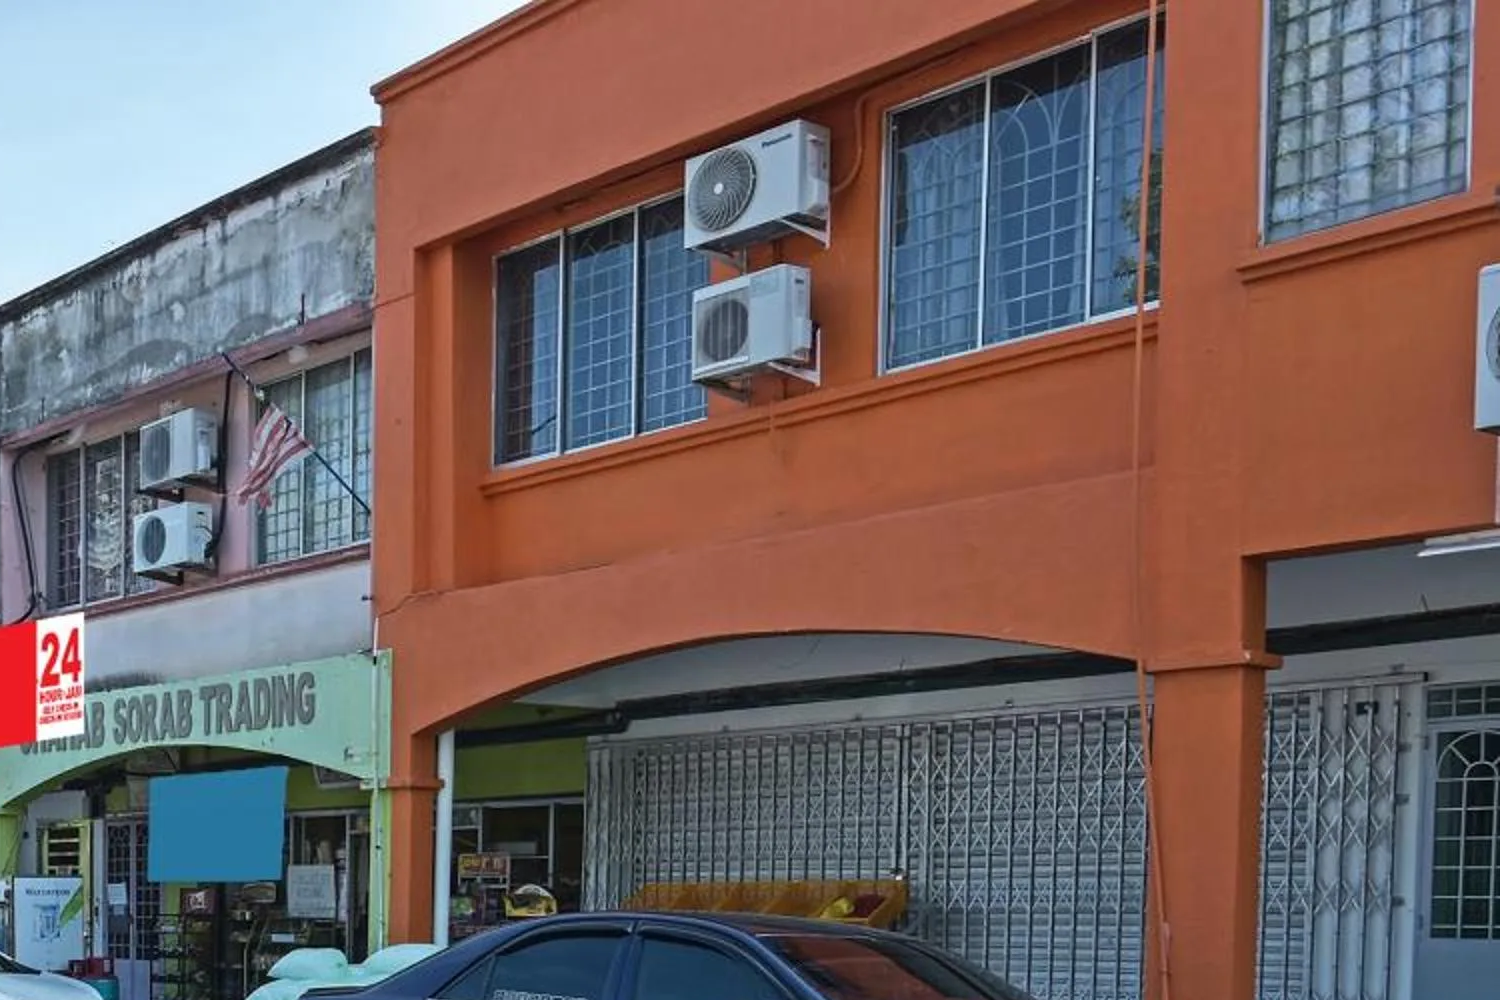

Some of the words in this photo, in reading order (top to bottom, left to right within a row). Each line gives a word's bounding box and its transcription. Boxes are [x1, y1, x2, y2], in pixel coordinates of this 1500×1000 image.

[41, 628, 81, 688] 24
[113, 689, 192, 745] SORAB
[200, 671, 316, 736] TRADING
